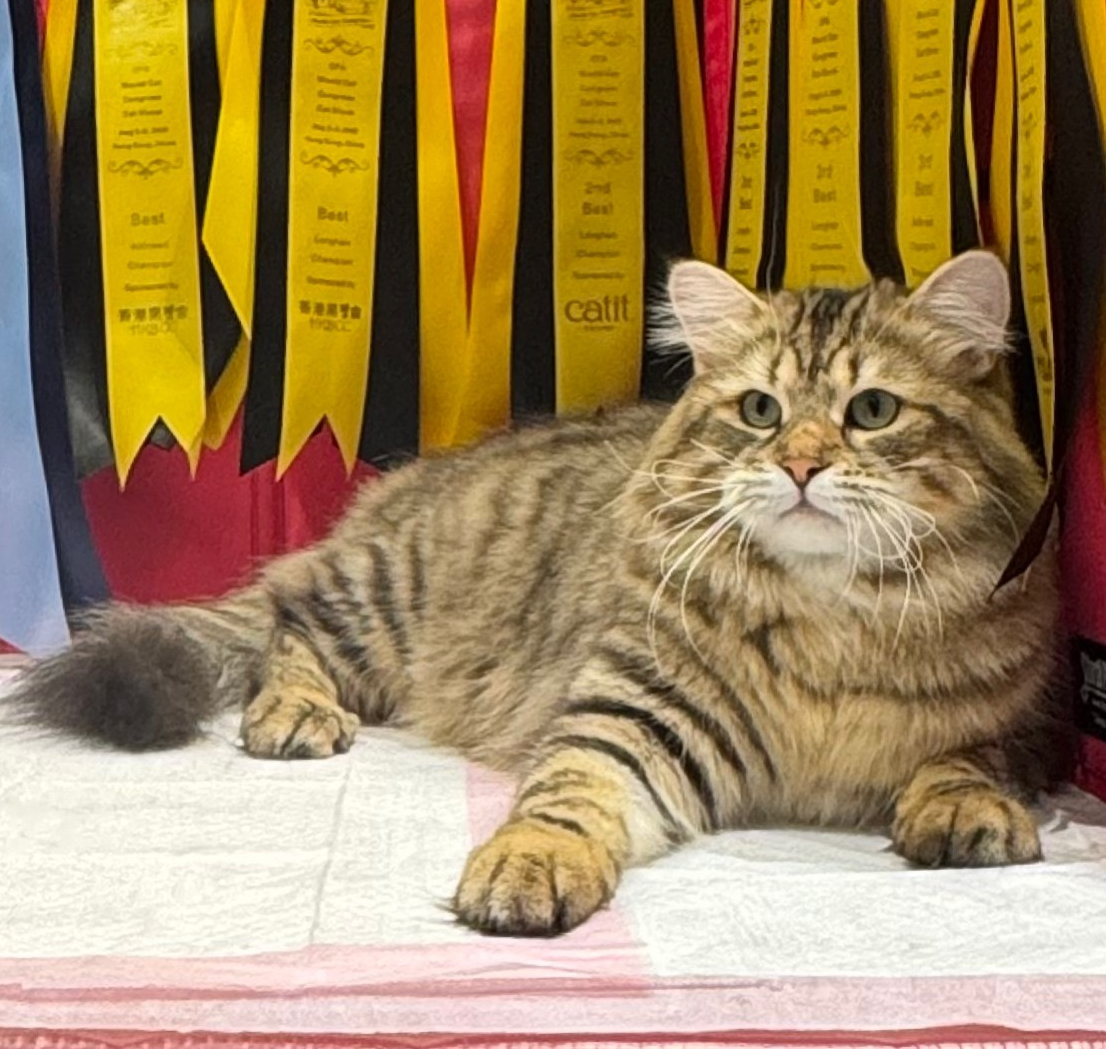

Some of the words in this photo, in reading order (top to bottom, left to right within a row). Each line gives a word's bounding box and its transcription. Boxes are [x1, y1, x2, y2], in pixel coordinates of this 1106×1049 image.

[317, 206, 349, 222] Best
[581, 202, 614, 216] Best
[130, 212, 166, 227] Best
[564, 294, 629, 323] catit
